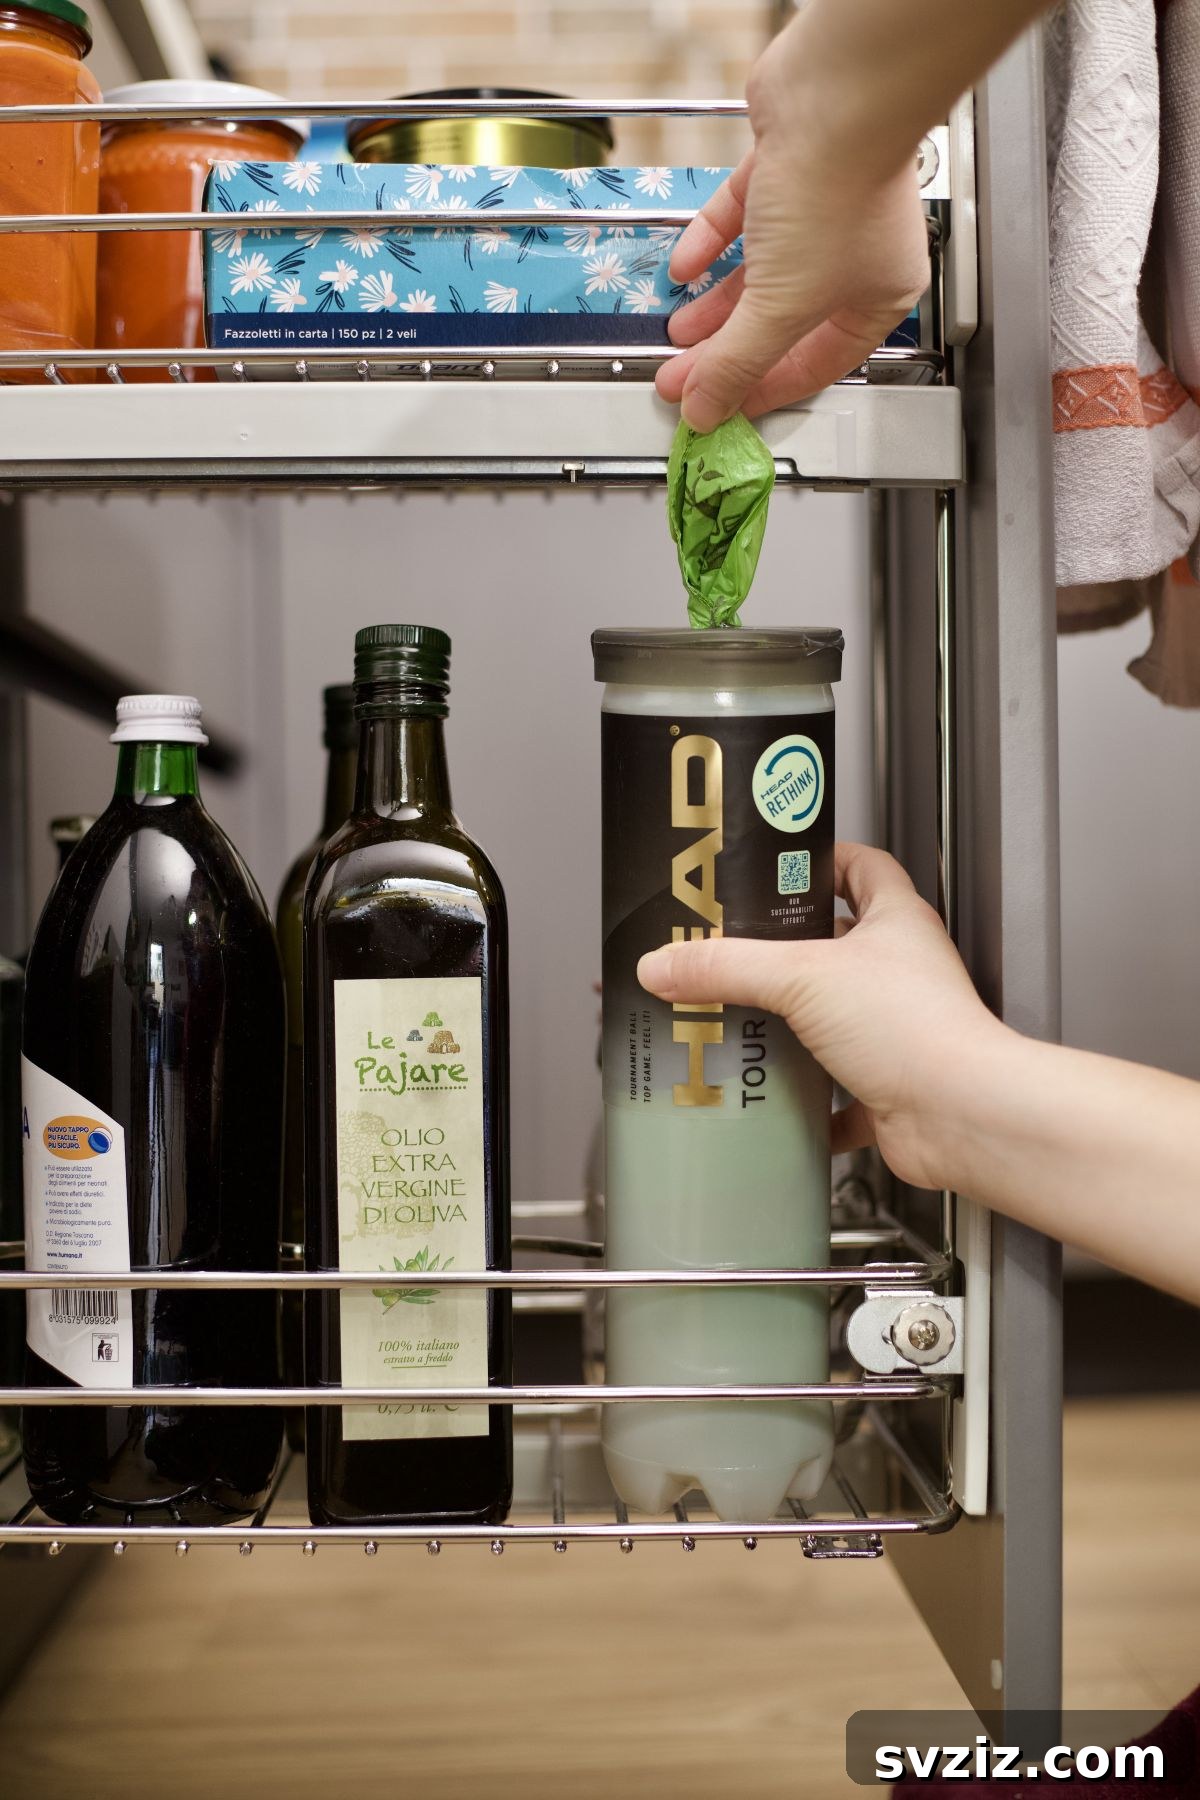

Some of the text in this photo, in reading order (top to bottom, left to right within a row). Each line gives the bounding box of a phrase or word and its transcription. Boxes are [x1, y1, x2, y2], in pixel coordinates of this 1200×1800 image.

[224, 328, 282, 339] Fazzoletti
[285, 328, 295, 339] in
[298, 329, 328, 339] carta
[338, 329, 358, 339] 150
[362, 330, 376, 341] pz
[386, 329, 393, 339] 2
[397, 328, 417, 339] veli
[760, 771, 793, 800] HEAD
[766, 767, 814, 818] RETHINK
[771, 905, 814, 916] SUSTAINABILITY
[789, 897, 800, 905] OUR
[782, 916, 806, 925] EFFORTS
[367, 1031, 396, 1050] Le
[629, 1011, 637, 1101] TOURNAMENT BALL
[642, 1010, 652, 1103] TOP GAME. FEEL IT!
[741, 1019, 767, 1109] TOUR
[354, 1051, 469, 1096] Pajare
[380, 1127, 445, 1147] OLIO
[371, 1153, 457, 1173] EXTRA
[361, 1178, 467, 1199] VERGINE
[363, 1203, 468, 1225] DI OLIVA
[378, 1338, 461, 1353] 100% italiano
[383, 1355, 415, 1364] estratto
[423, 1352, 454, 1366] freddo
